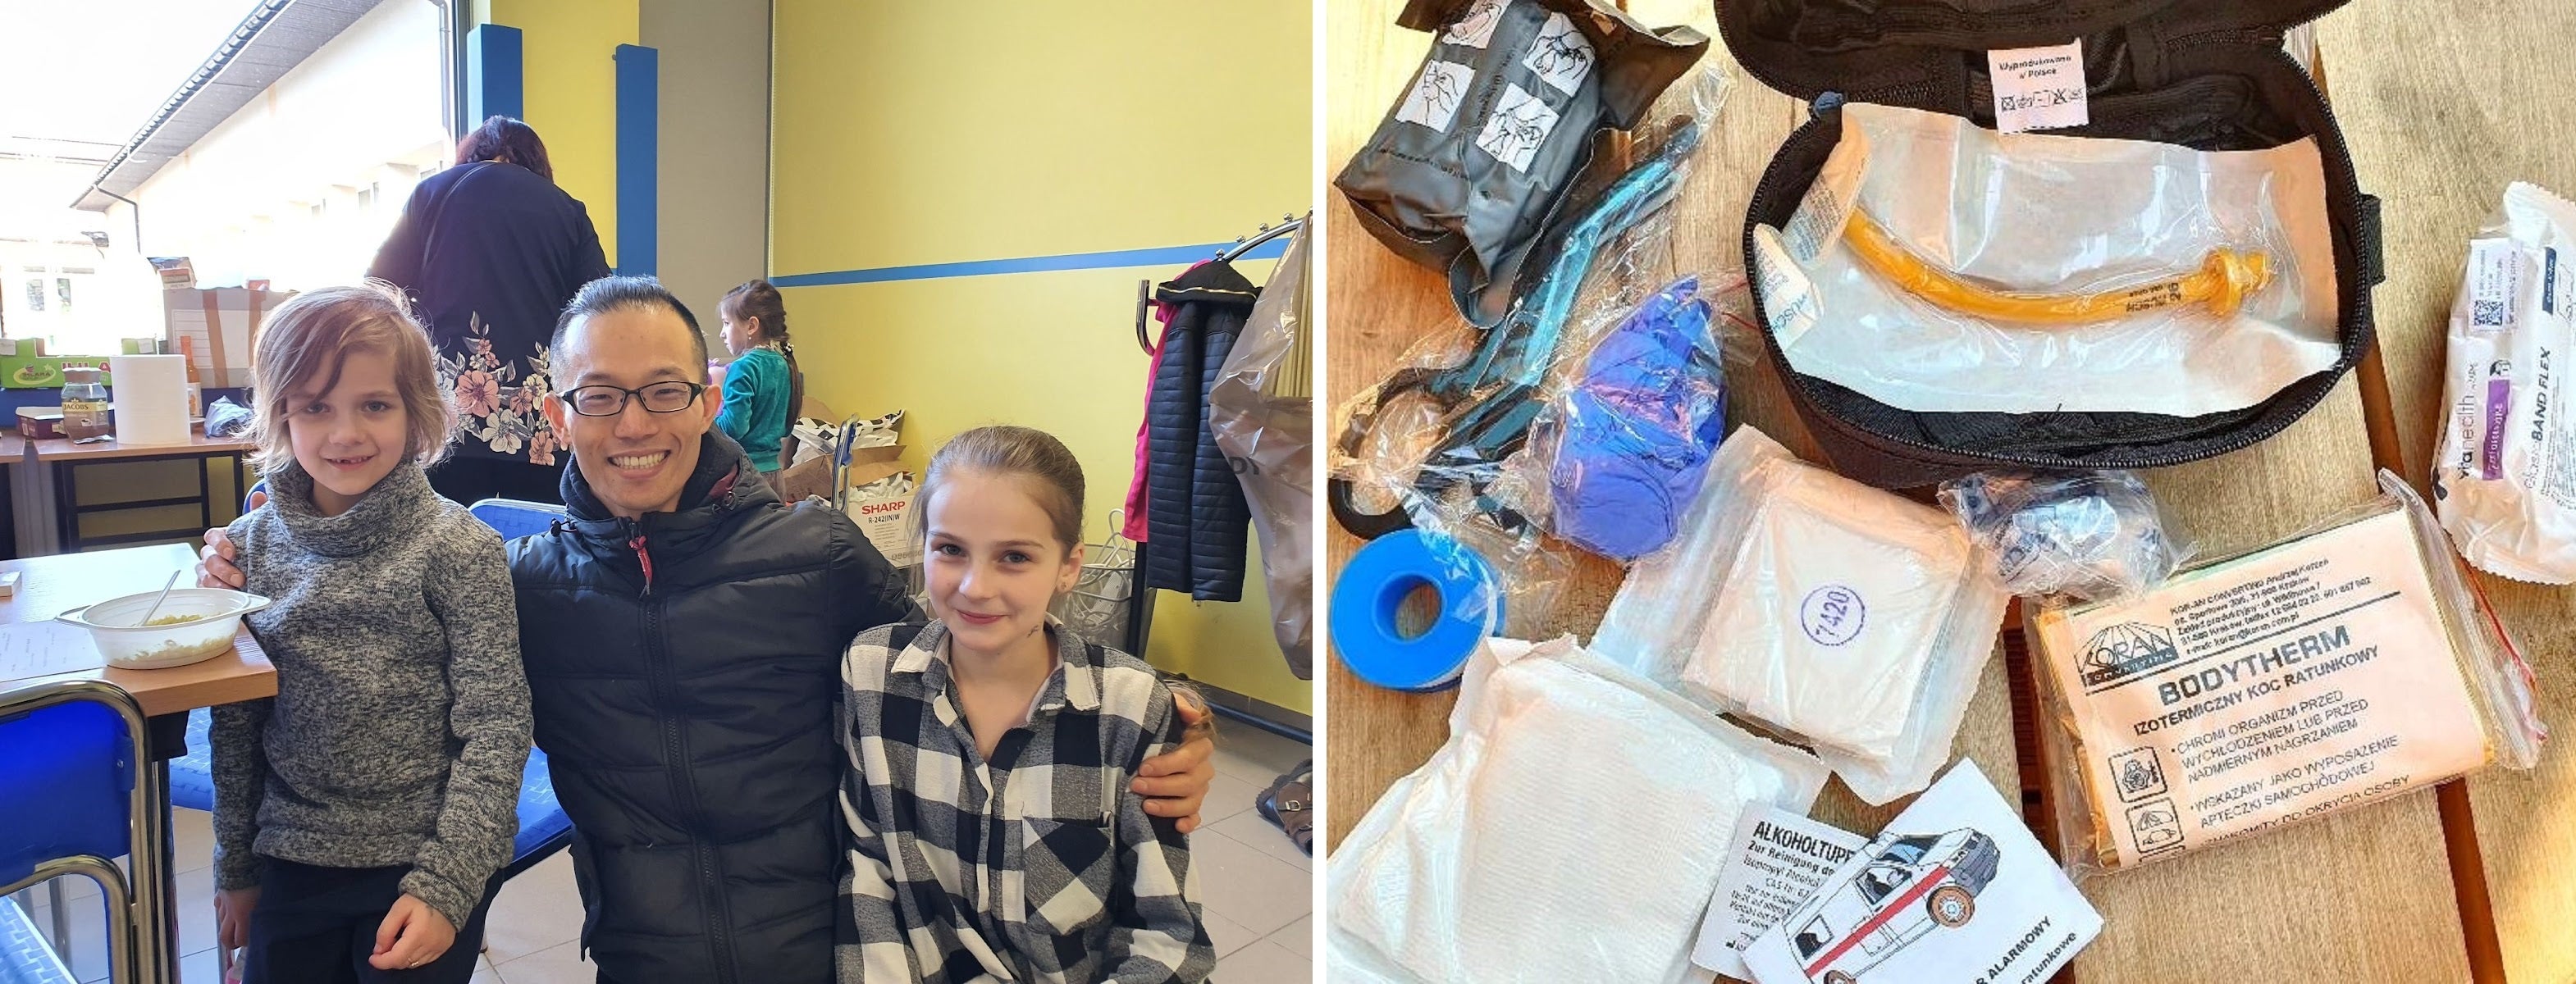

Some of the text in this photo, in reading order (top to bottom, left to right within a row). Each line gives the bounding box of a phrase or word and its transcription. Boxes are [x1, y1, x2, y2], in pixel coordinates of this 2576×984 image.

[2538, 346, 2551, 390] FLEX
[861, 501, 906, 515] SHARP
[868, 513, 901, 524] R-242(IN)W
[1816, 591, 1850, 637] 7420
[2158, 625, 2350, 705] BODYTHERM
[2134, 645, 2378, 736] IZOTERMICZNY KOC RATUNKOWY
[2177, 690, 2344, 755] CHRONI ORGANIZM PRZED
[2297, 713, 2323, 731] LUB
[2325, 699, 2369, 721] PRZED
[2187, 718, 2359, 784] NADMIERNYM NAGRZANIEM
[2194, 781, 2266, 812] WSKAZANY
[2269, 767, 2302, 786] JAKO
[2305, 791, 2361, 816] OKRYCIA
[2364, 774, 2410, 796] OSOBY
[2199, 799, 2263, 828] APTECZKI
[1748, 840, 1765, 854] Zur
[1767, 847, 1820, 872] Reinigung
[1988, 915, 2051, 980] ALARMOWY
[2021, 932, 2076, 984] ratunkowe
